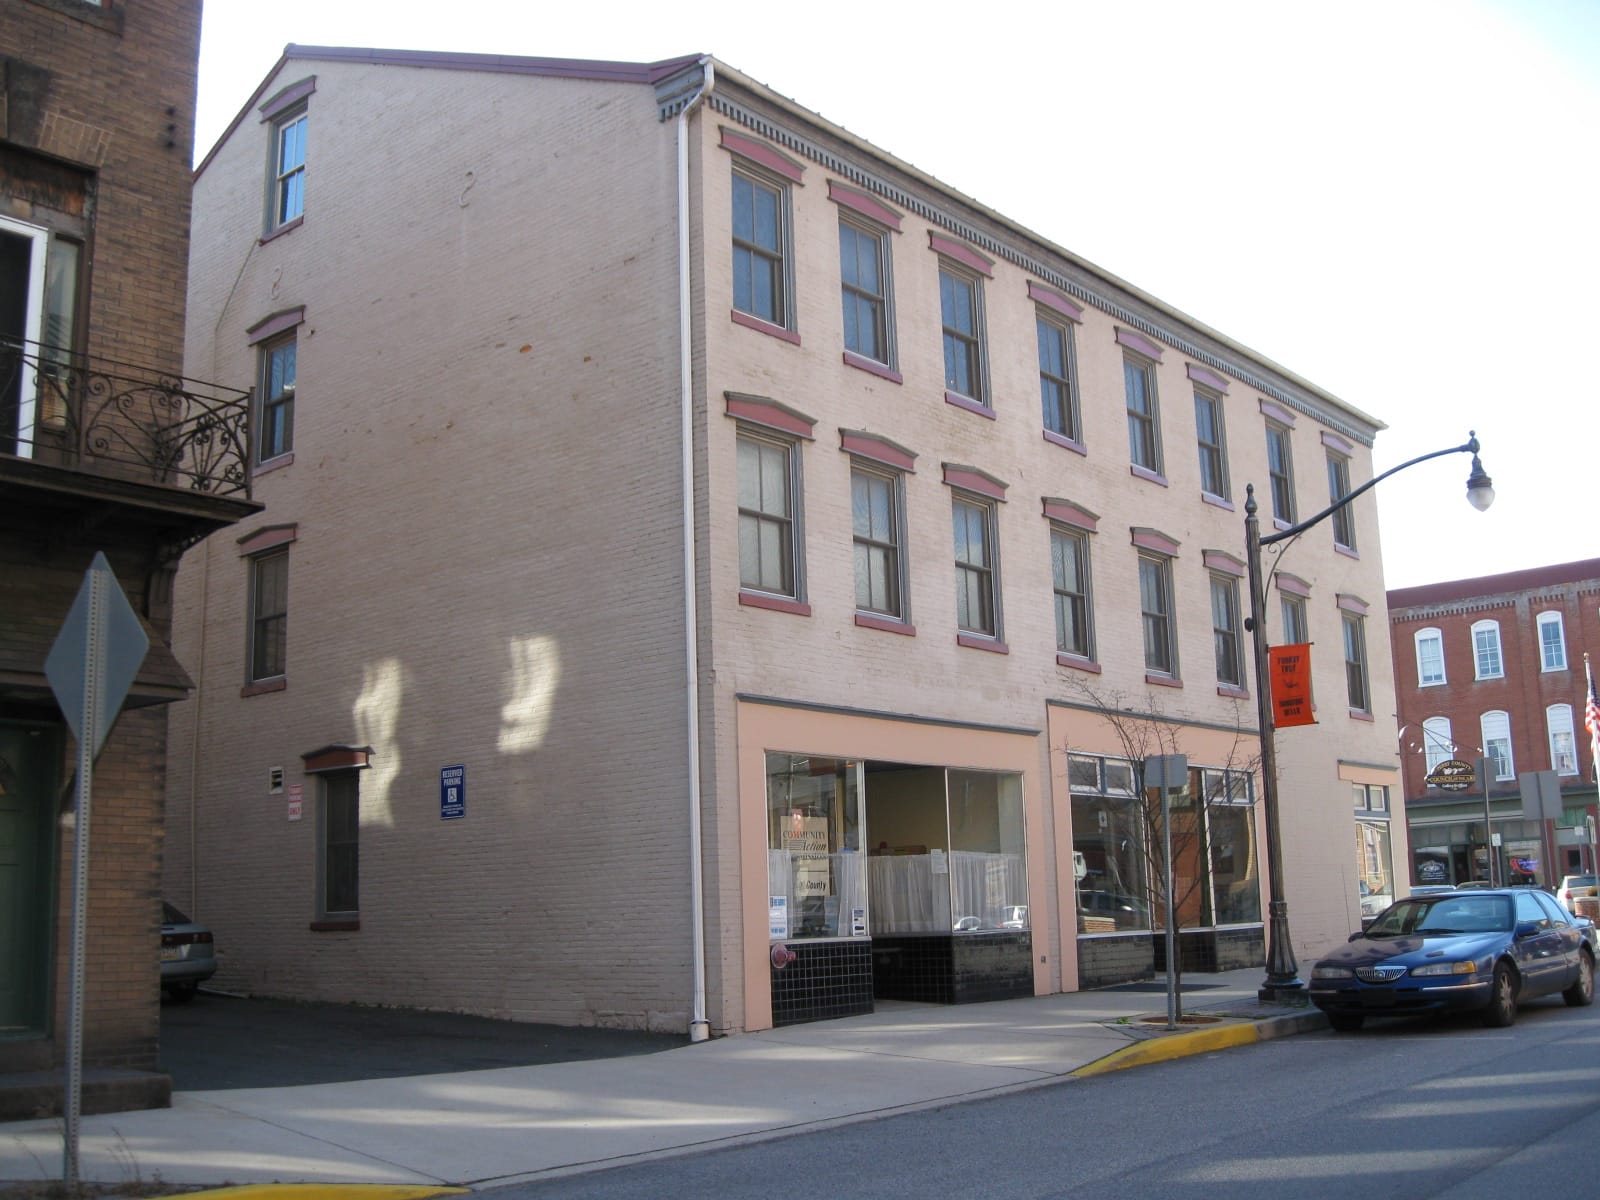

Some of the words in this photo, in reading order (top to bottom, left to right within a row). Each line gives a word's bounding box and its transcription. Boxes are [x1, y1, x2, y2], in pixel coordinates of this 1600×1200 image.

[443, 778, 461, 786] PARKING
[782, 831, 826, 839] COMMUNITY
[802, 842, 827, 850] Action
[806, 881, 826, 891] County
